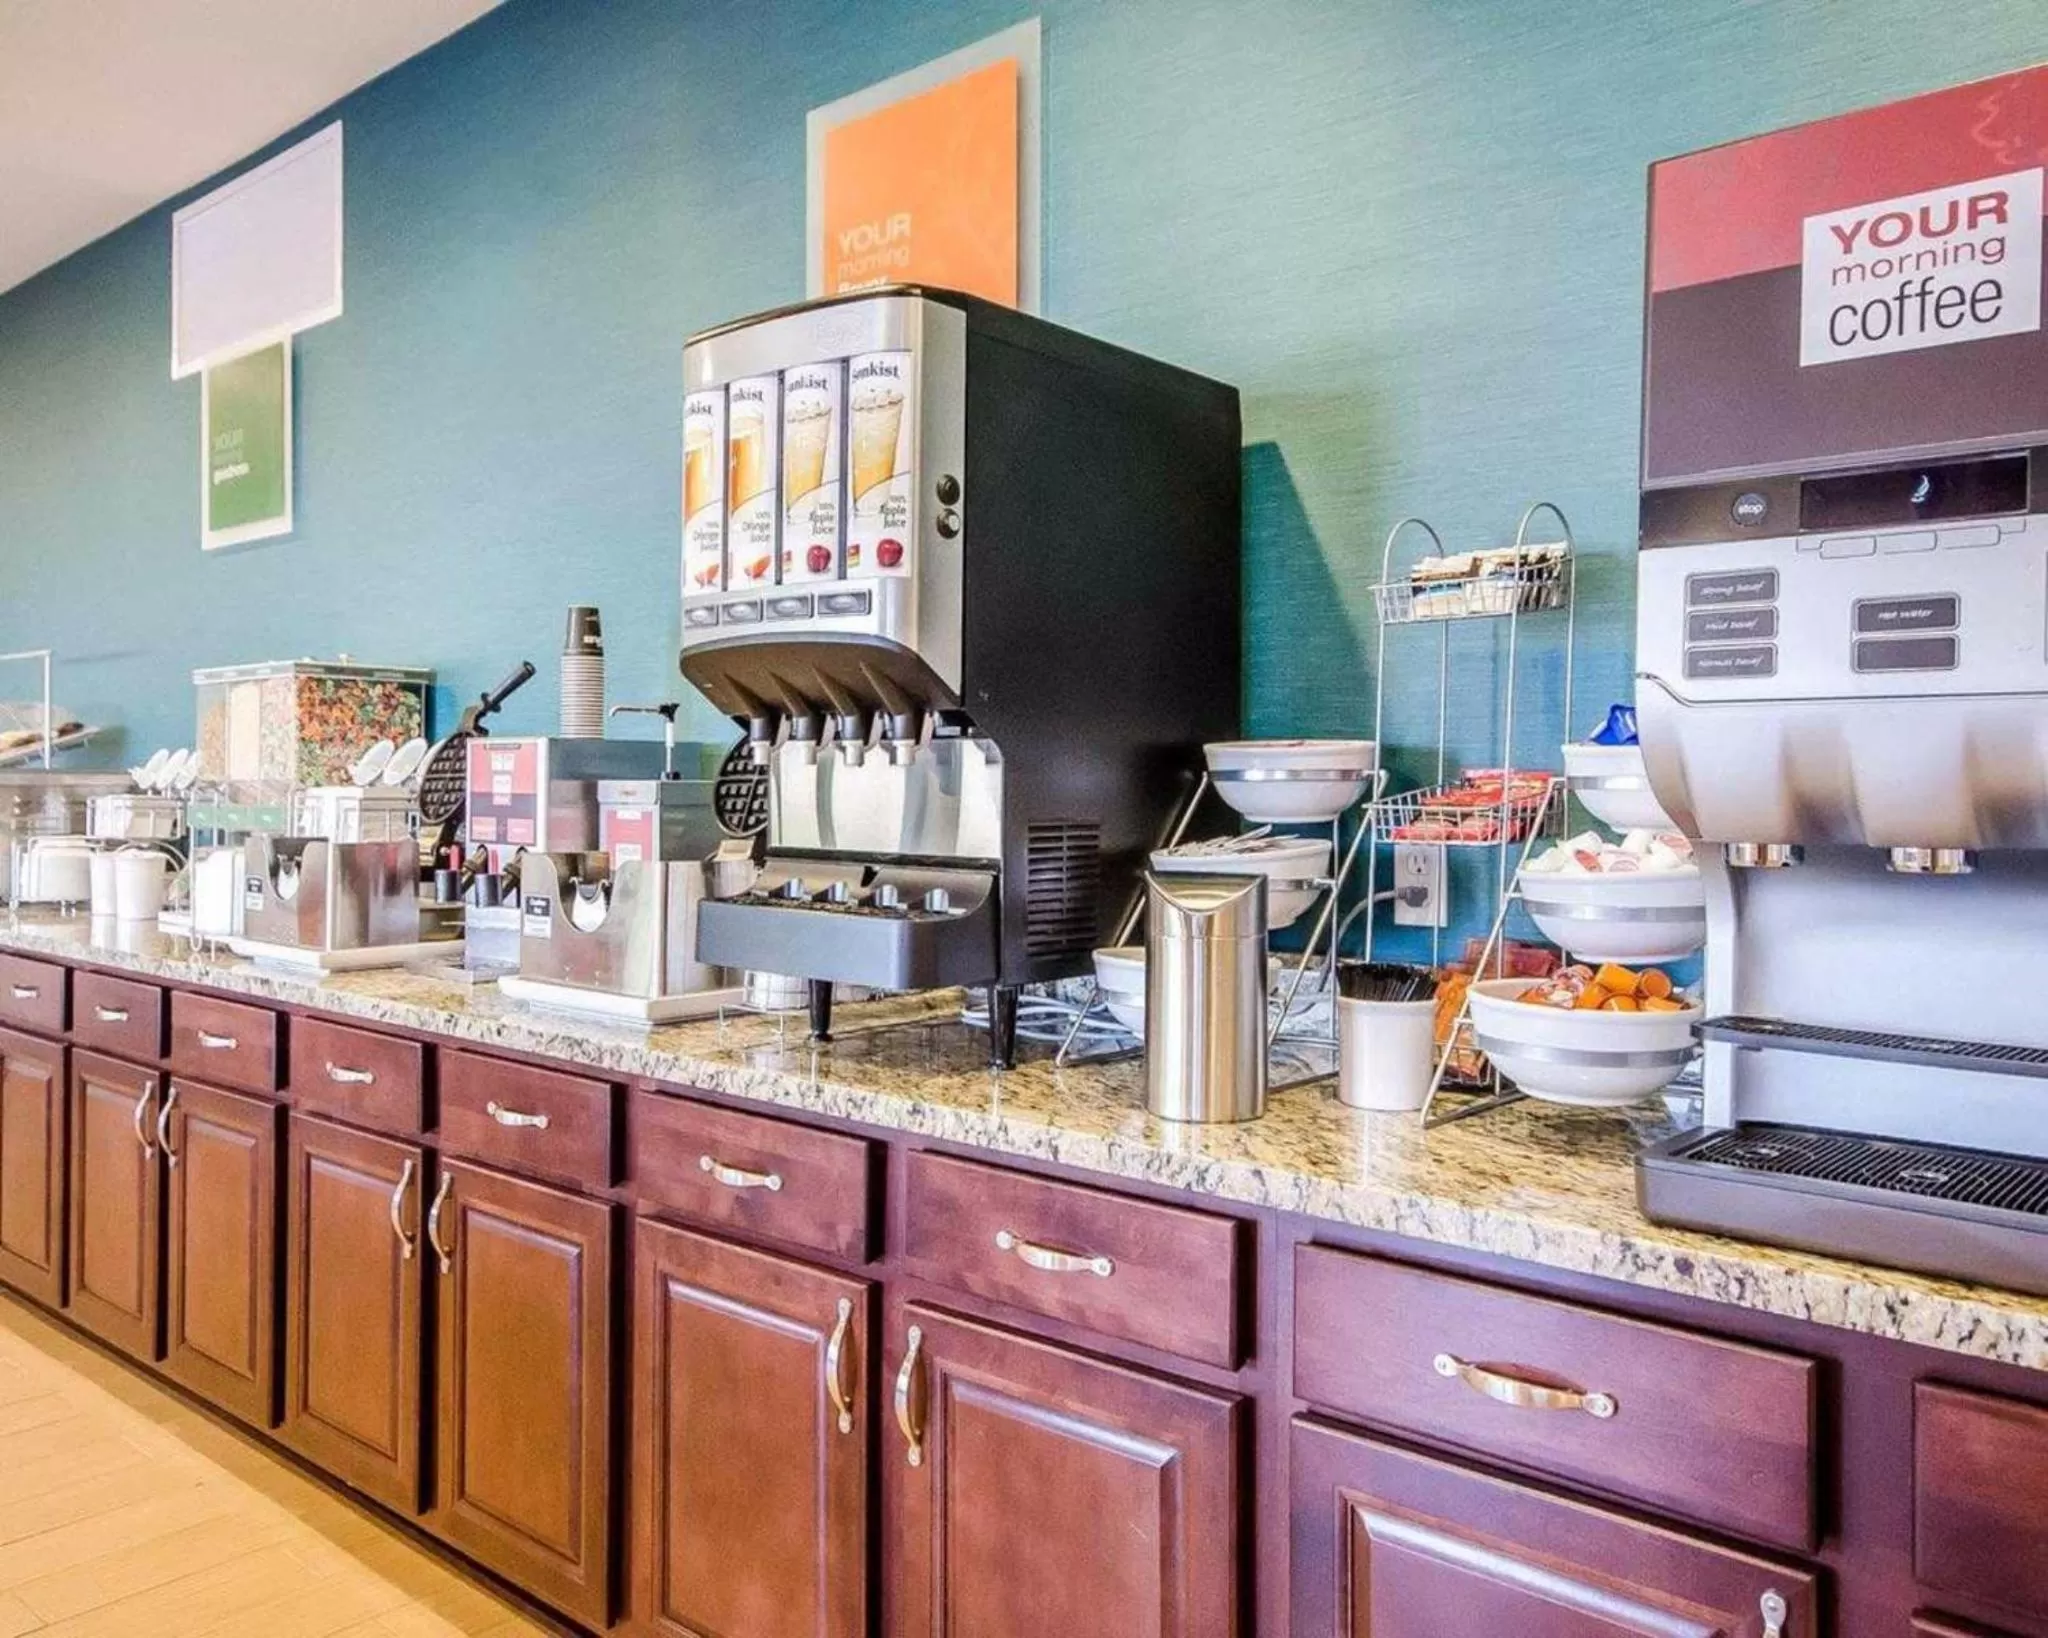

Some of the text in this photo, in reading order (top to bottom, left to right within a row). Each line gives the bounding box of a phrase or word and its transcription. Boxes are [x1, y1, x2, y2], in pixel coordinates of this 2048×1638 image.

[838, 212, 911, 256] YOUR
[1829, 190, 2010, 255] YOUR
[1831, 235, 2006, 286] morning
[1829, 276, 2004, 347] coffee
